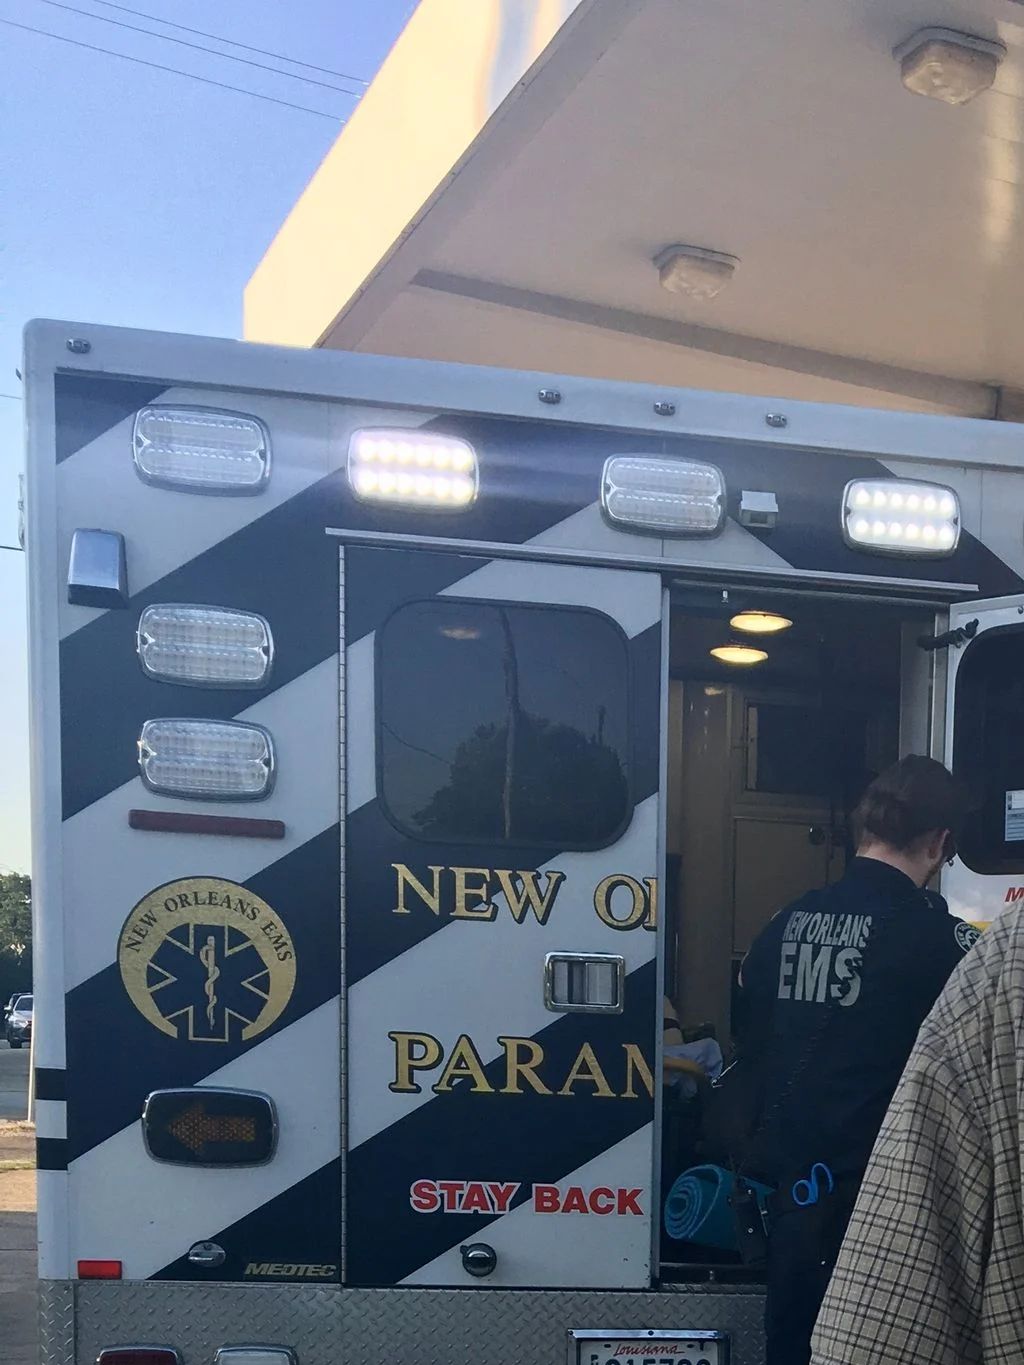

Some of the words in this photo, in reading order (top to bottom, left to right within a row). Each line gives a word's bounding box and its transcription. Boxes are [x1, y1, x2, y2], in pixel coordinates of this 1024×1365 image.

[392, 863, 566, 926] NEW
[125, 909, 158, 952] NEW
[163, 891, 261, 921] ORLEANS
[261, 920, 292, 962] EMS
[806, 912, 872, 947] ORLEANS
[778, 942, 863, 1007] EMS
[410, 1179, 522, 1214] STAY
[532, 1183, 645, 1216] BACK
[244, 1263, 337, 1277] MEDTEC
[613, 1343, 685, 1357] Louisiana
